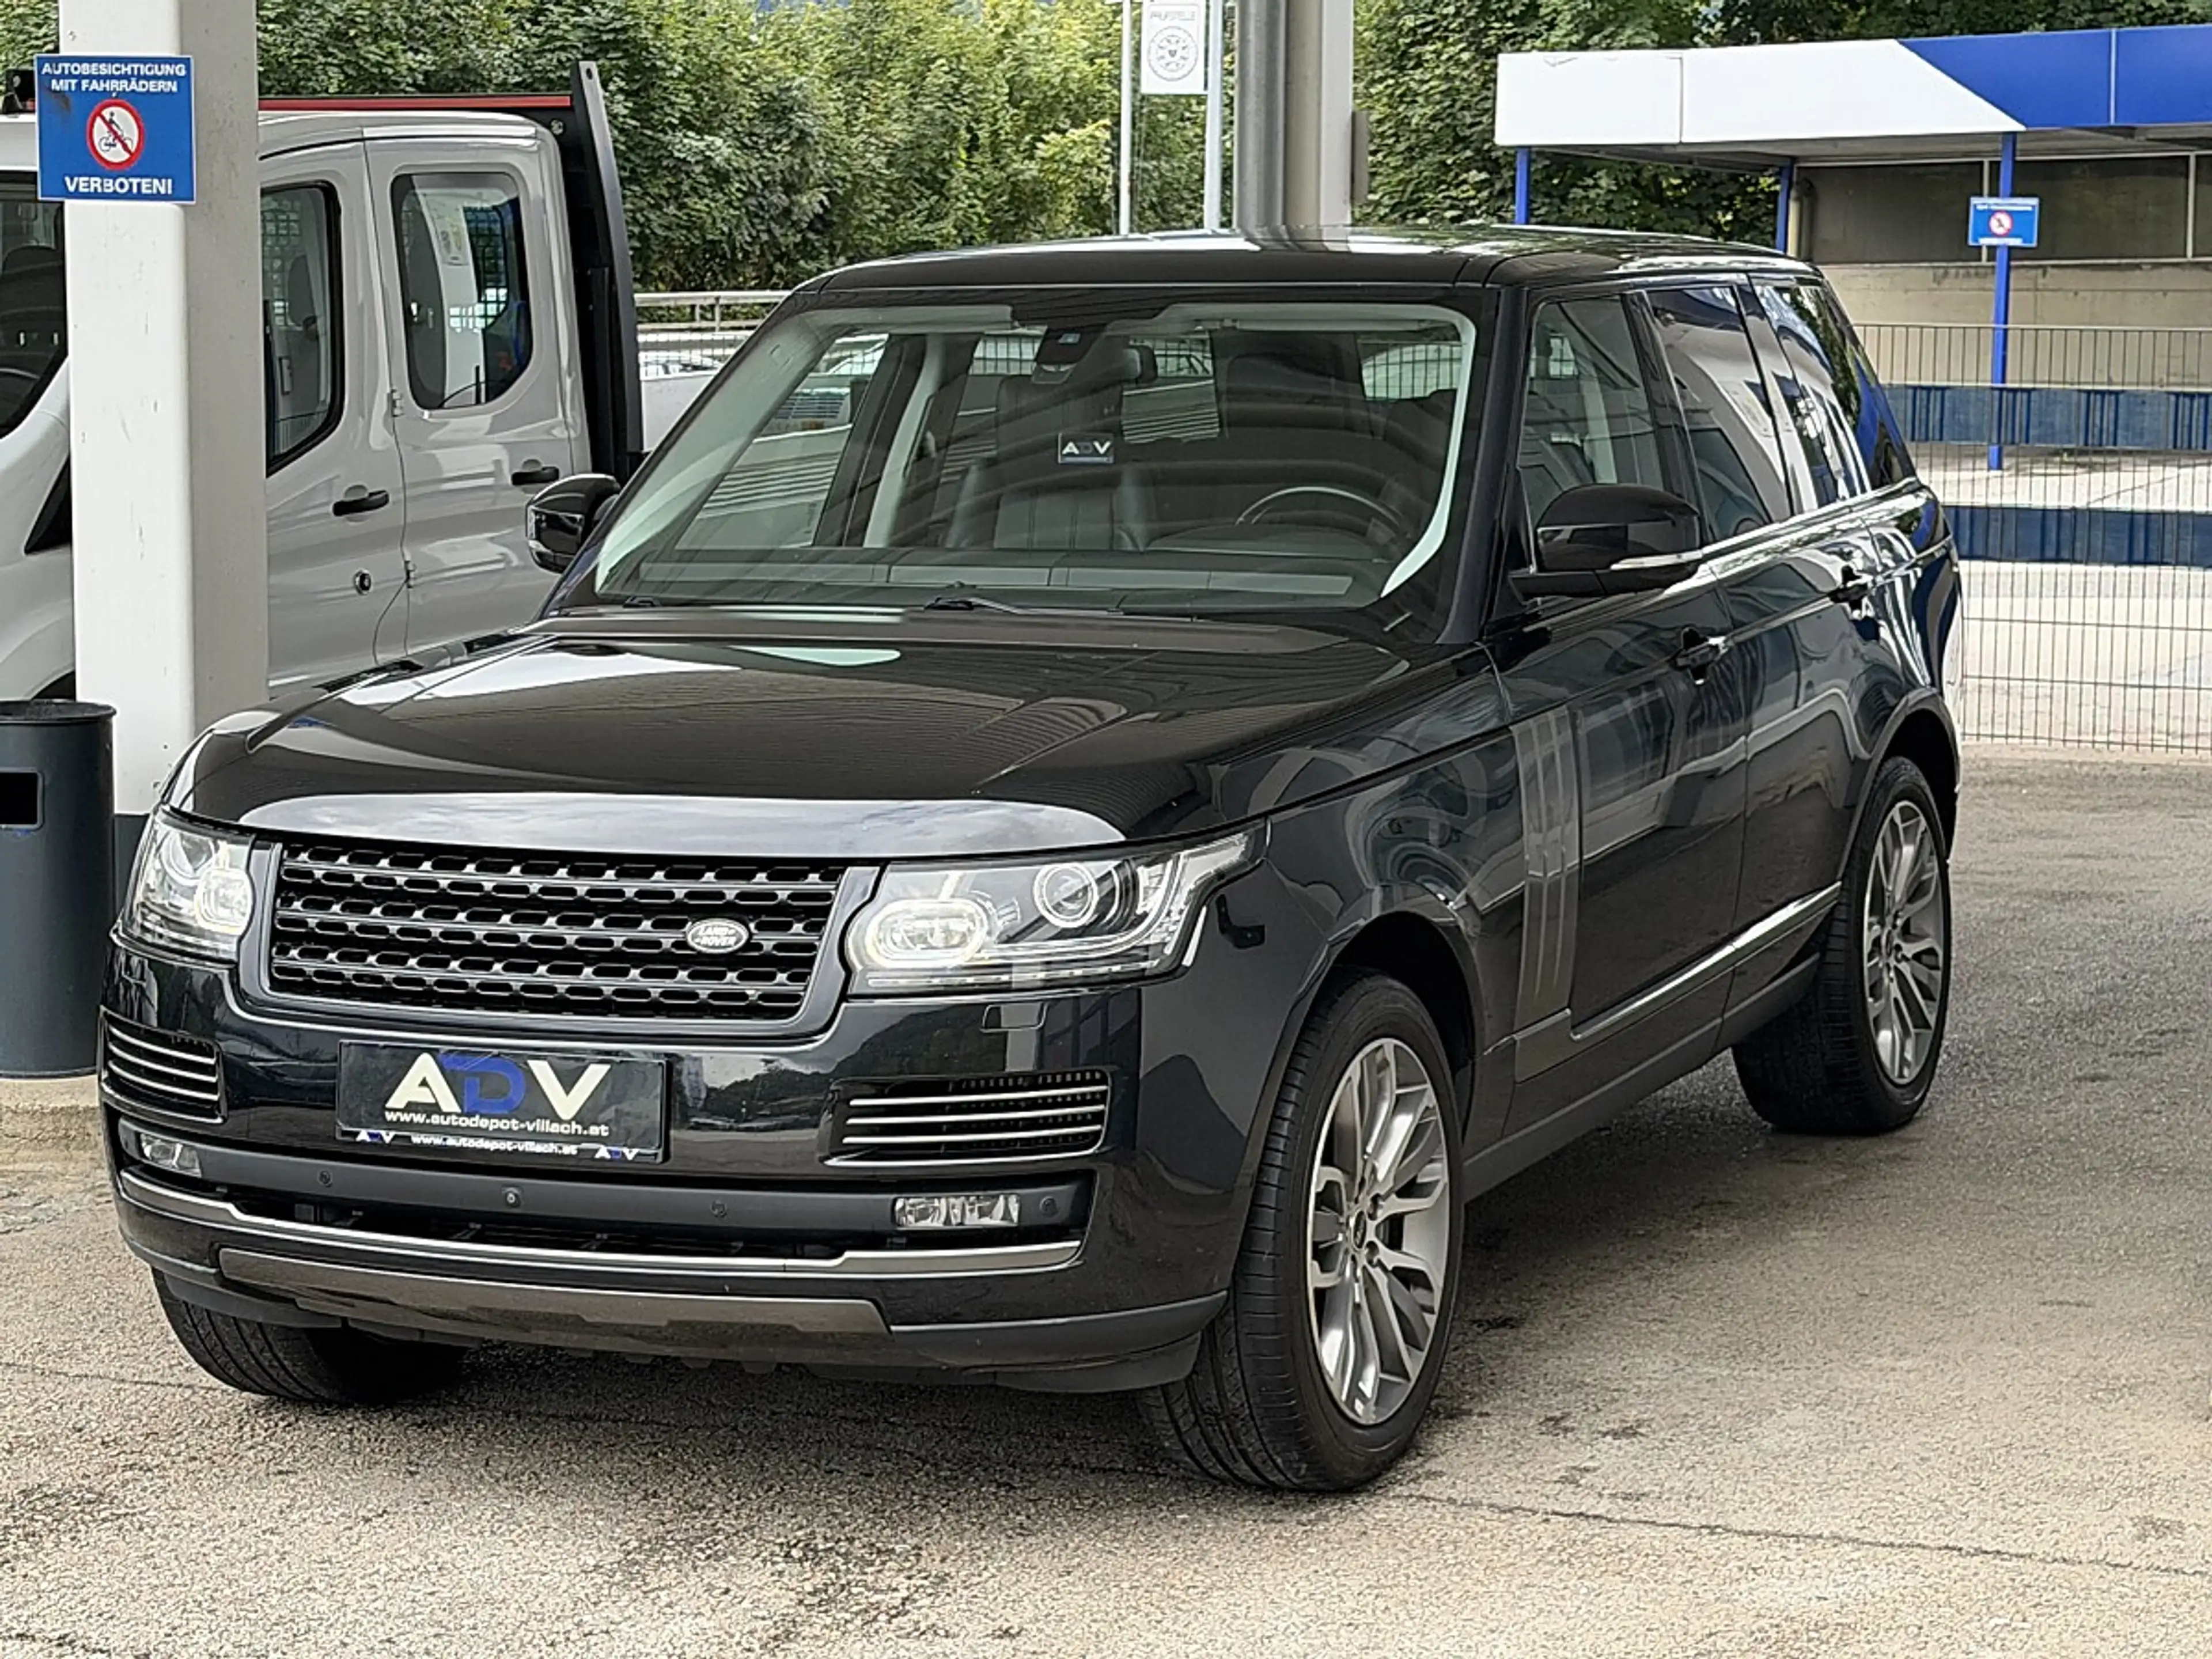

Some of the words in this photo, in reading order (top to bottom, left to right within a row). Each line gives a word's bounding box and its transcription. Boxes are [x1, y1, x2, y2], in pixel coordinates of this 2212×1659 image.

[41, 62, 186, 77] AUTOBESICHTIGUNG
[51, 79, 78, 92] MIT
[81, 77, 178, 93] FAHRRÄDERN
[698, 926, 728, 935] LAND
[700, 936, 737, 946] ROVER
[384, 1052, 611, 1121] ADV
[384, 1109, 609, 1137] www.autodepot-villach.at
[410, 1134, 578, 1155] www.autodepot-villach.at
